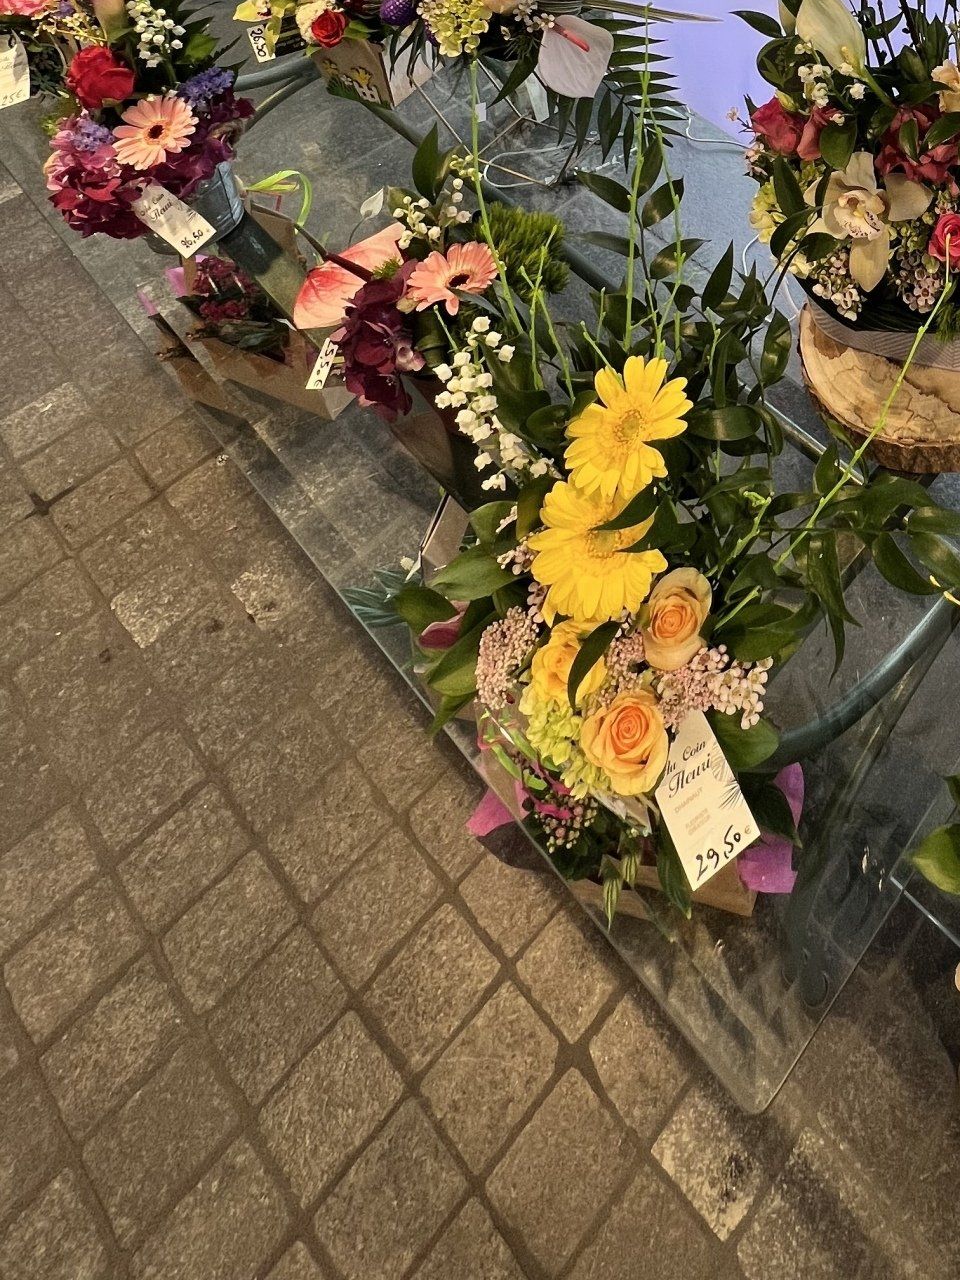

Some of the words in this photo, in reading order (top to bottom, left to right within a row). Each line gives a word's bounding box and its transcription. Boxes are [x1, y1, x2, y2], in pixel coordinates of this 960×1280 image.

[683, 740, 706, 761] Coin
[669, 754, 711, 798] Fleuri
[696, 825, 741, 881] 29,50
[744, 826, 752, 834] €
